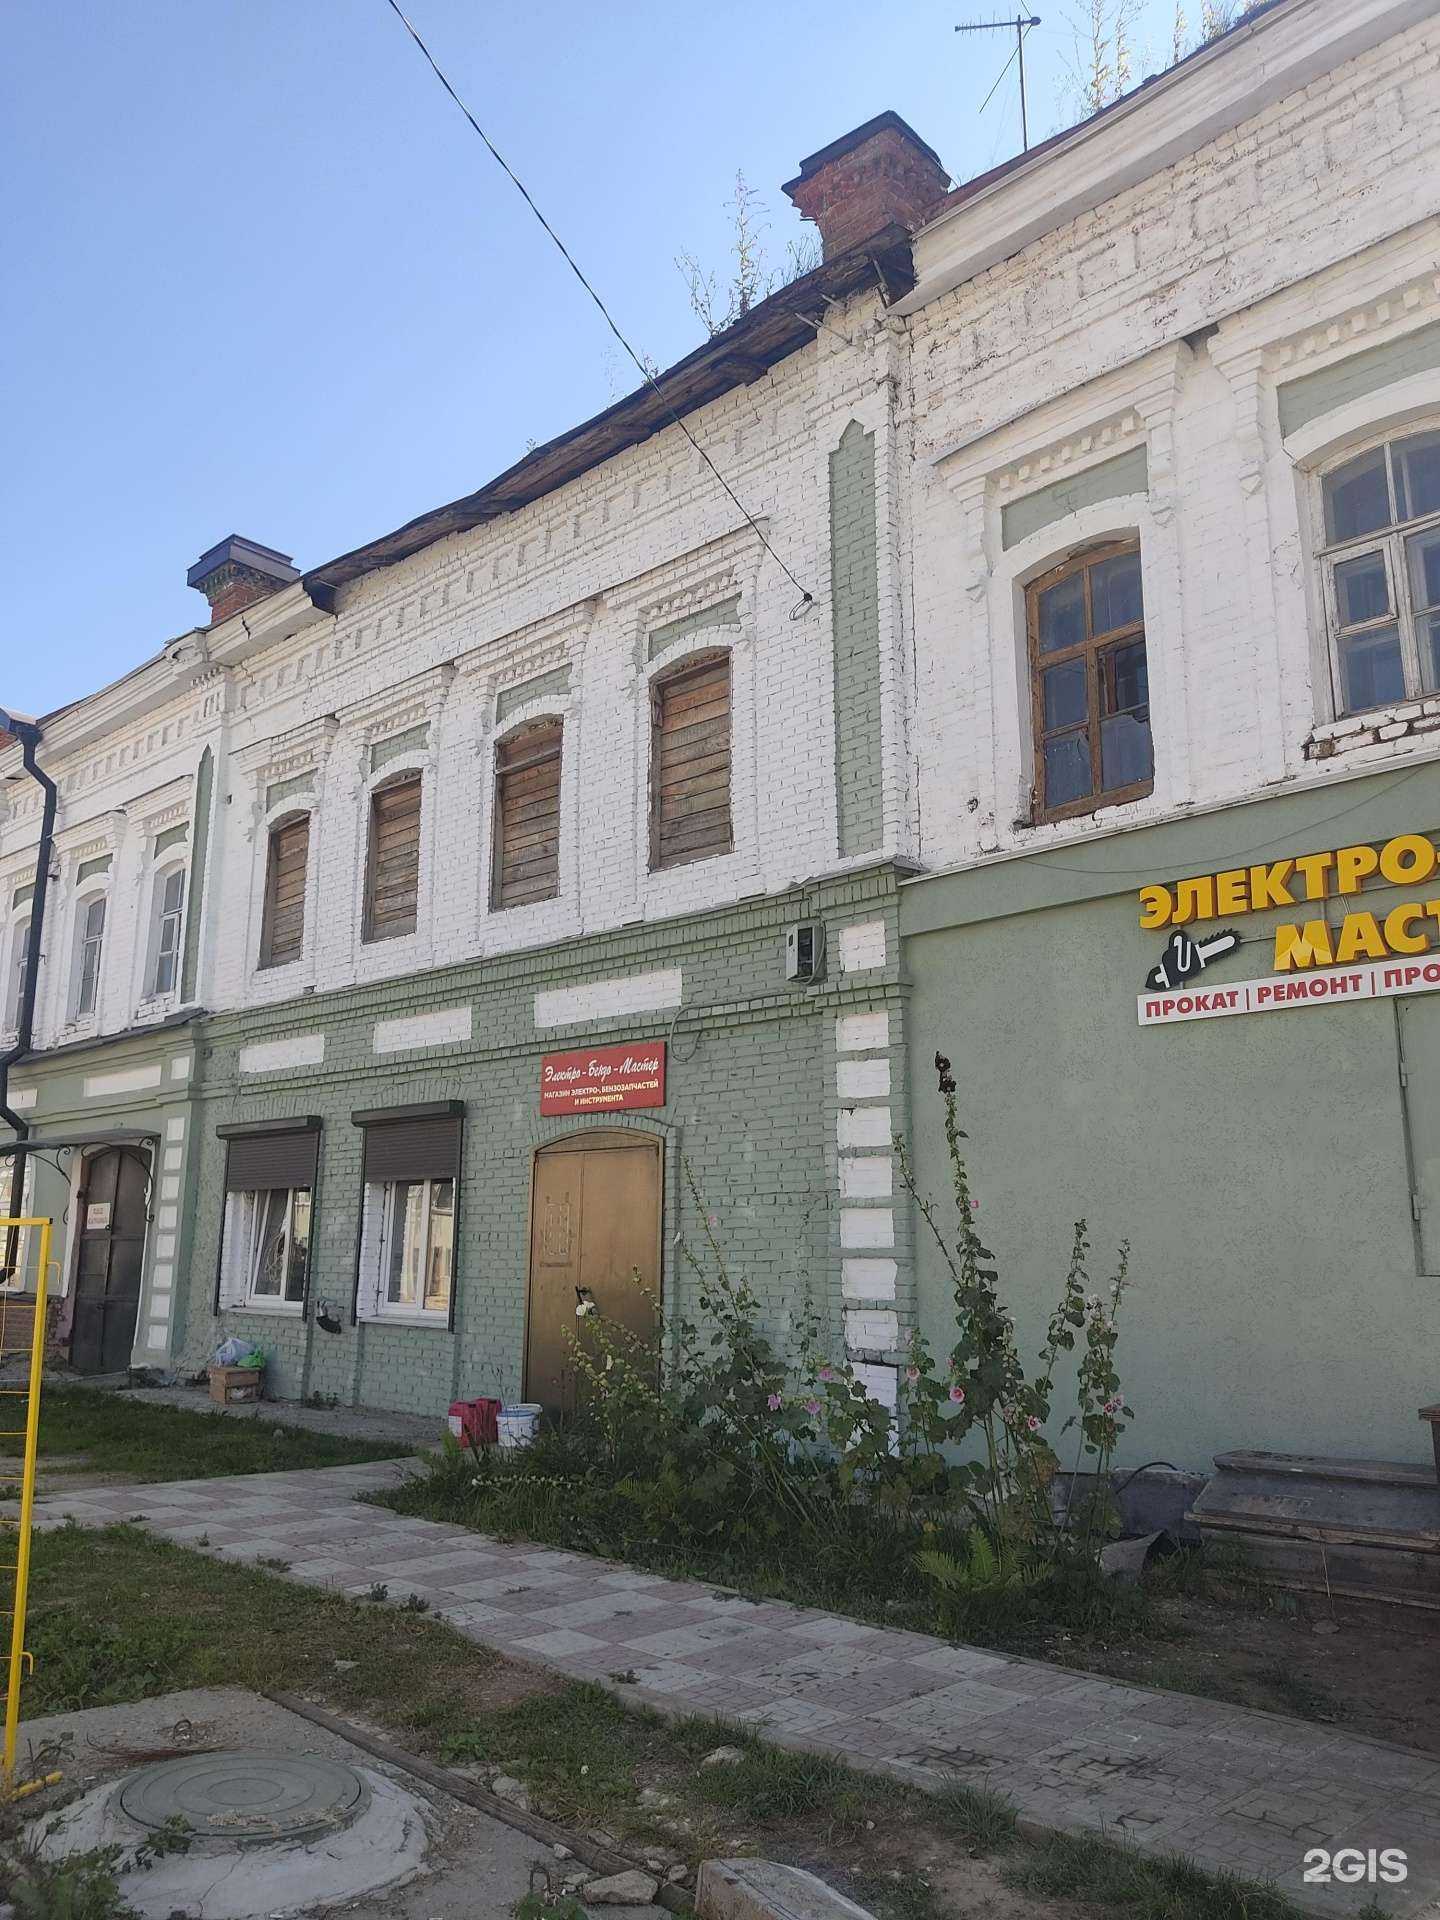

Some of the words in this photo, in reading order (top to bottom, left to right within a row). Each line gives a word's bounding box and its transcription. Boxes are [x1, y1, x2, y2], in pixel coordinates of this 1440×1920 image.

[1139, 834, 1440, 930] ЭЛЕКТРО
[1145, 990, 1239, 1018] ПРОКАТ
[1257, 973, 1364, 1004] РЕМОНТ
[544, 1089, 571, 1099] МАГАЗИН
[602, 1078, 659, 1093] БЕНЗОЗАПЧАСТЕЙ
[574, 1098, 580, 1106] И
[580, 1094, 624, 1105] ИНСТРУМЕНТА
